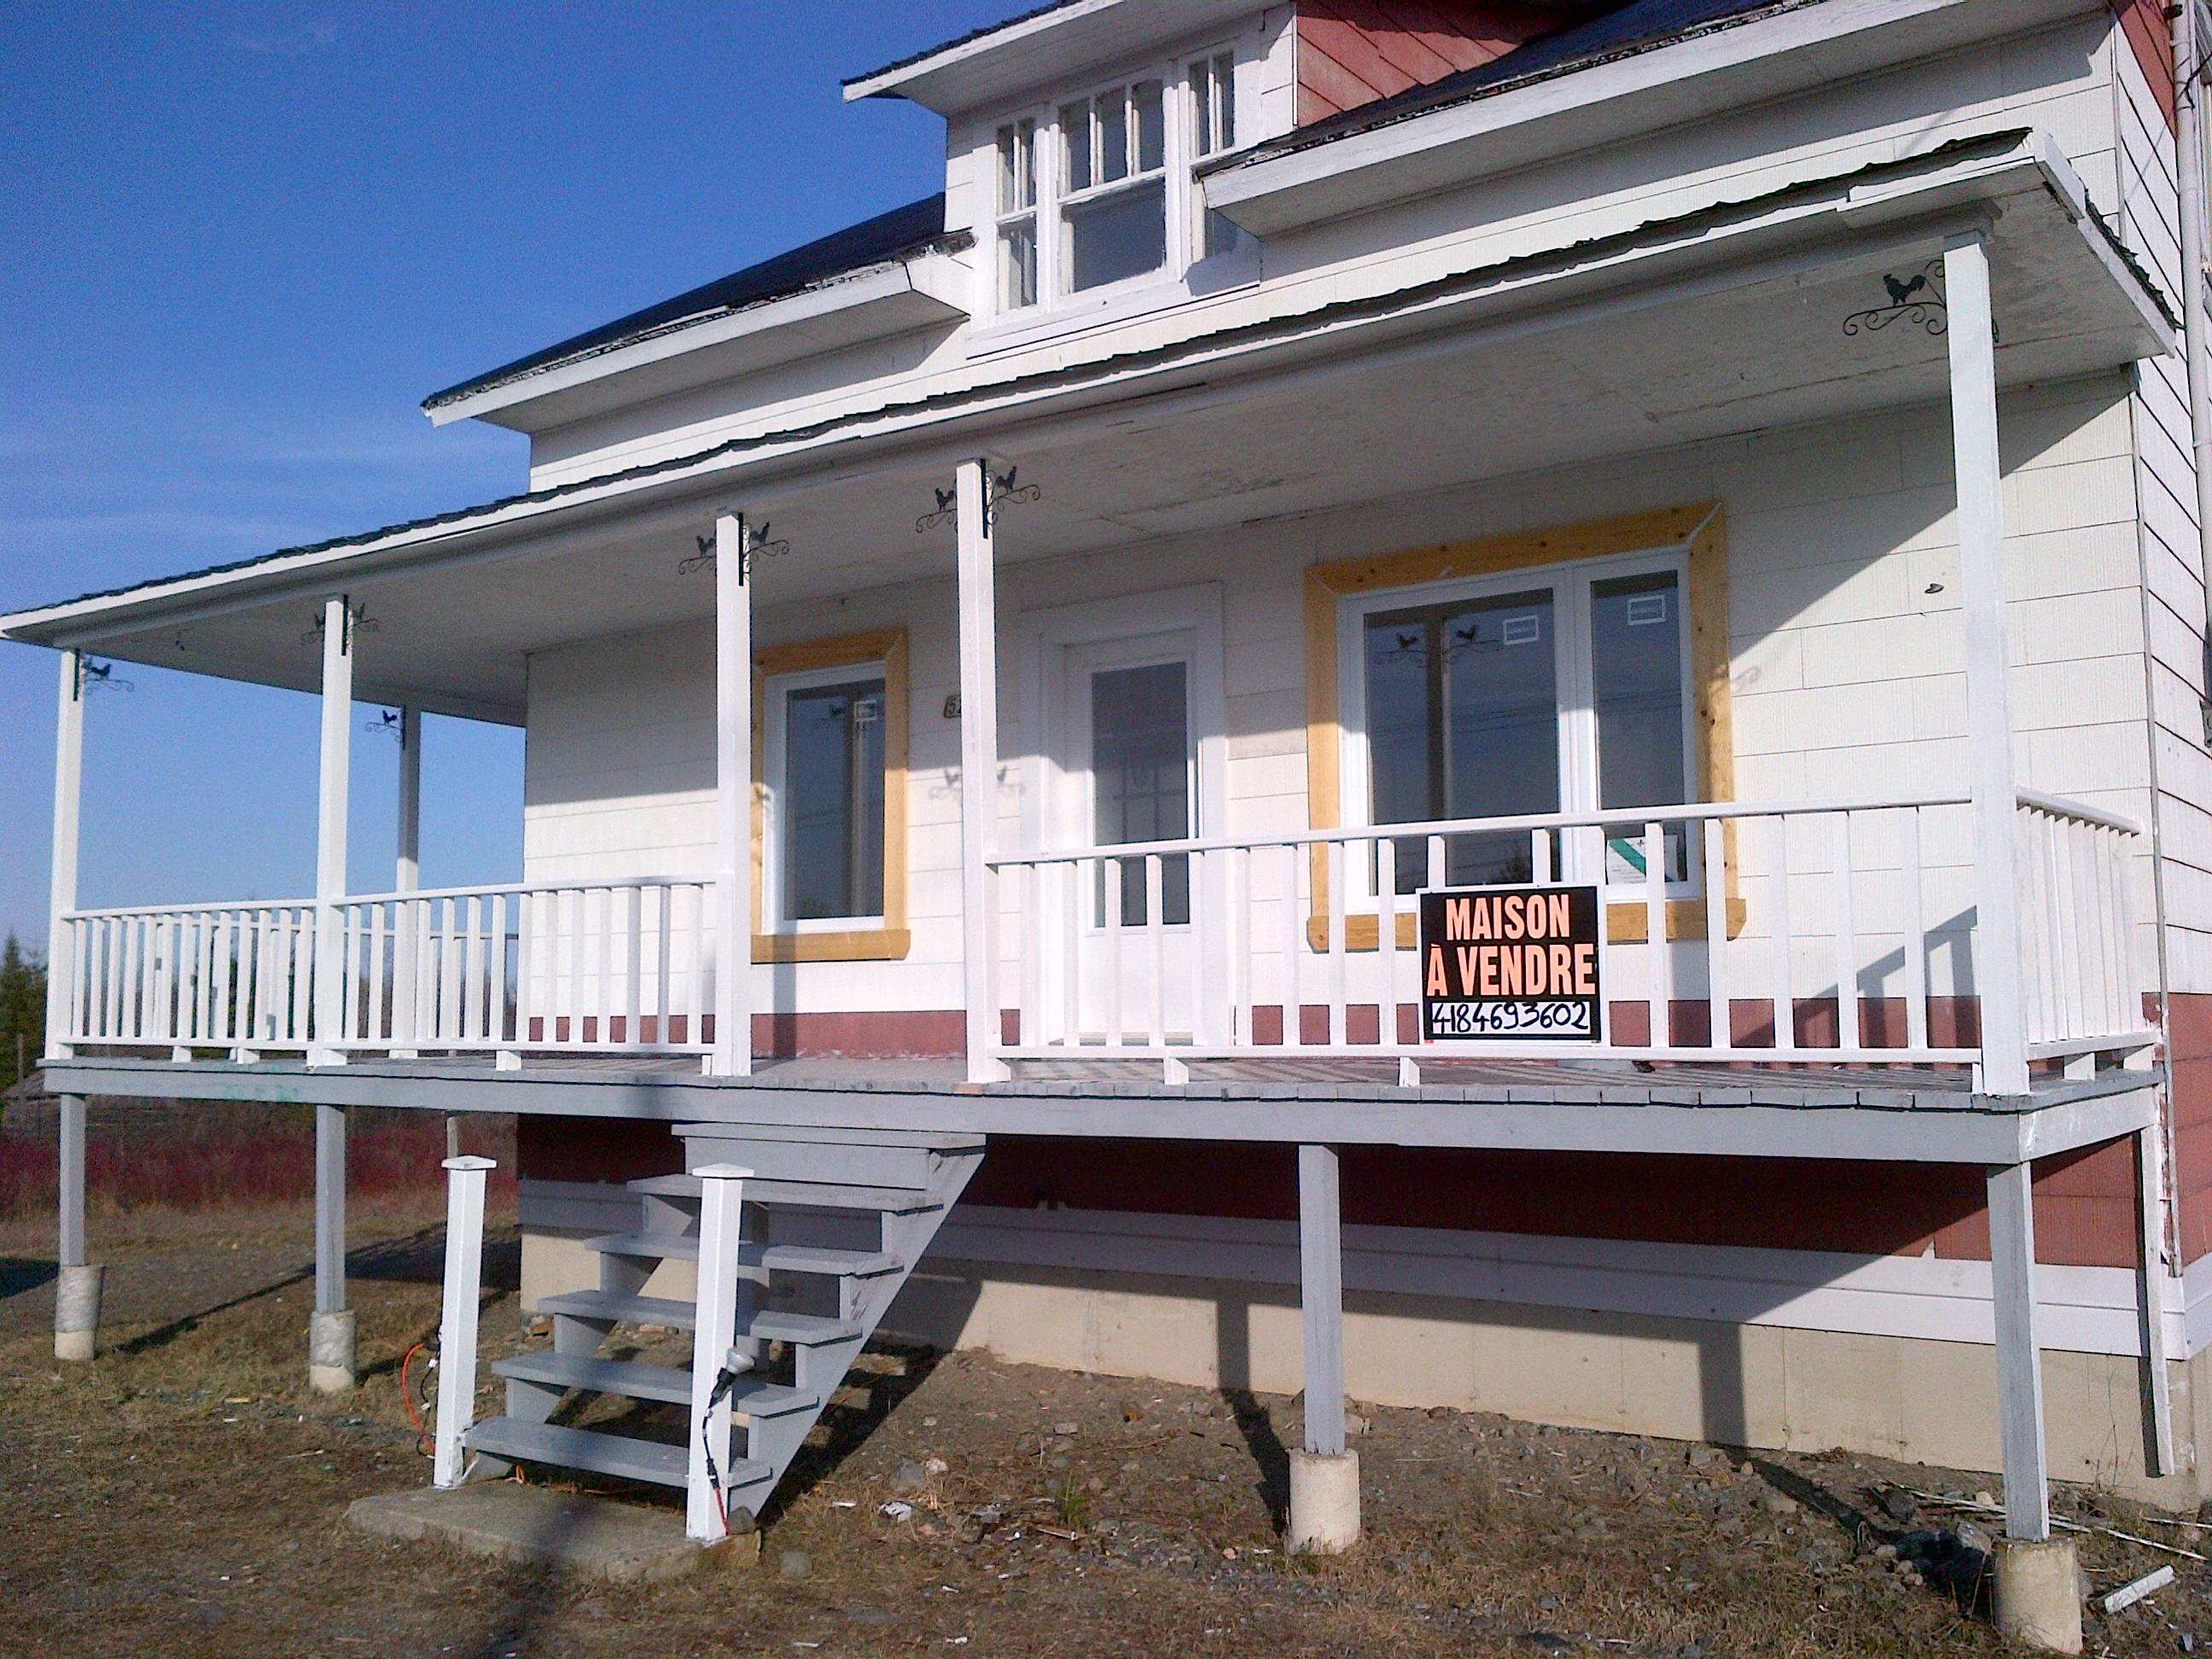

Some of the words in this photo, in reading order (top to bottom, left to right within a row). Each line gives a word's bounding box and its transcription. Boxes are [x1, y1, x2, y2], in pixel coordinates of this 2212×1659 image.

[1446, 894, 1570, 941] MAISON
[1426, 942, 1448, 997] À
[1457, 943, 1596, 997] VENDRE
